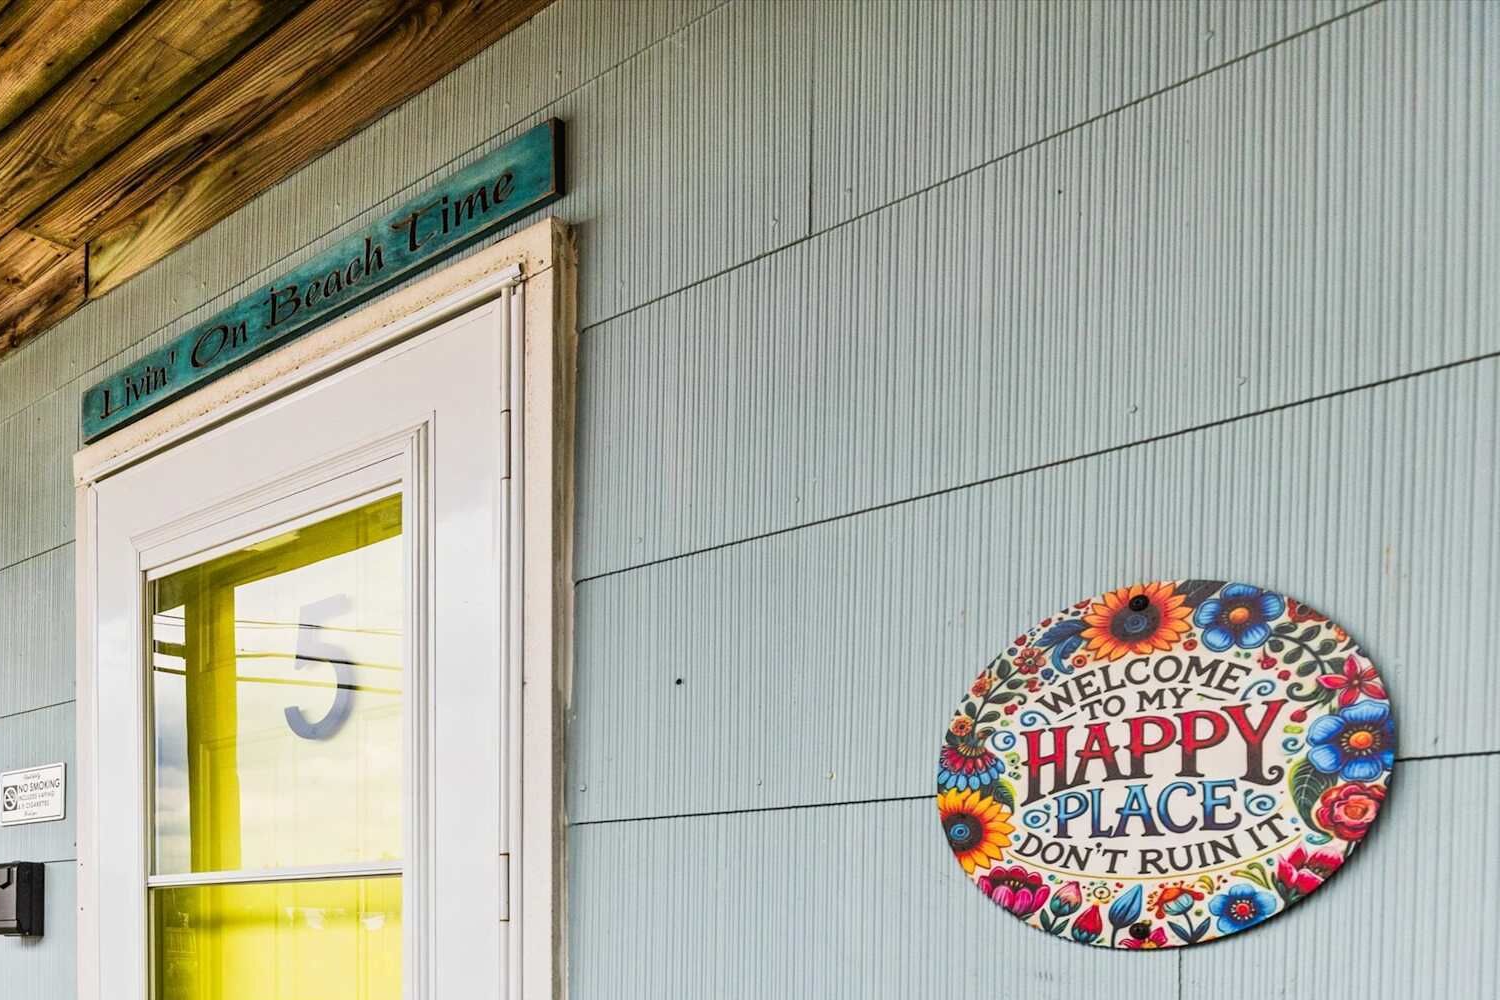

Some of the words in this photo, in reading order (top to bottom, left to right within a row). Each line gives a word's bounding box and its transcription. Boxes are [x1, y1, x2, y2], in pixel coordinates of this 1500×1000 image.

[100, 350, 176, 420] Livin'
[191, 321, 247, 369] On
[265, 237, 384, 330] Beach
[392, 169, 515, 253] Time
[284, 594, 355, 741] 5
[1035, 655, 1252, 716] WELCOME
[1081, 699, 1126, 722] TO
[1136, 688, 1193, 712] MY
[1019, 699, 1289, 807] HAPPY
[18, 783, 29, 793] NO
[1053, 778, 1242, 839] PLACE
[1015, 831, 1128, 875] DON'T
[1140, 834, 1240, 875] RUIN
